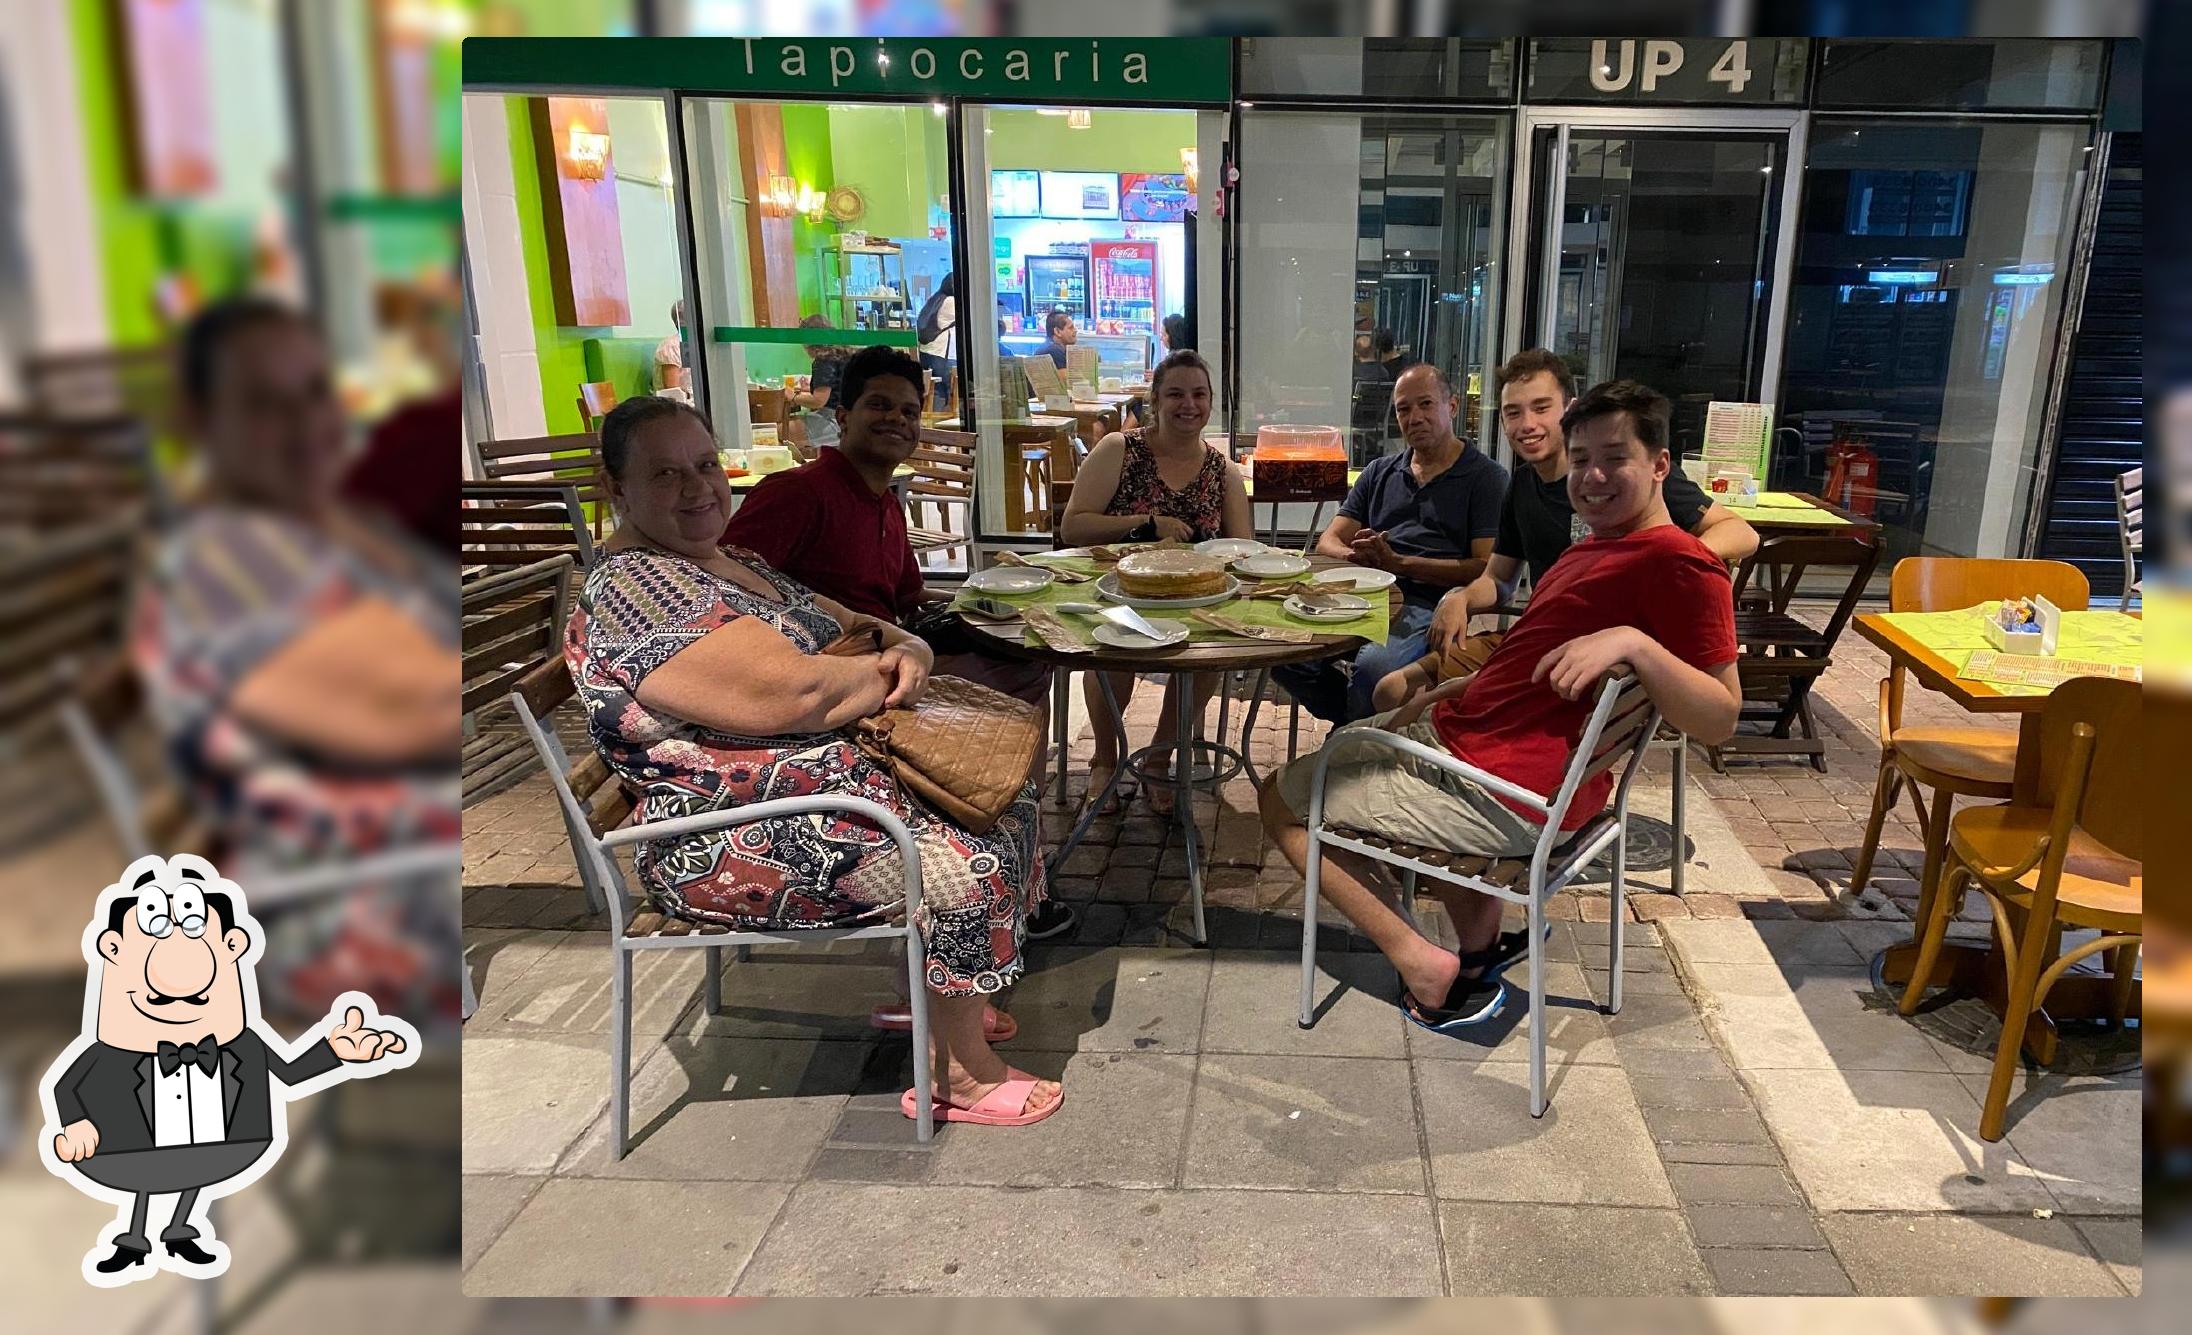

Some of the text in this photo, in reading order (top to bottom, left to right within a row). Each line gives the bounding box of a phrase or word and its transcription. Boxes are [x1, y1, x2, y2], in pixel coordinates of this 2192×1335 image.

[742, 37, 1148, 87] Tapiocaria
[1589, 39, 1752, 93] UP 4
